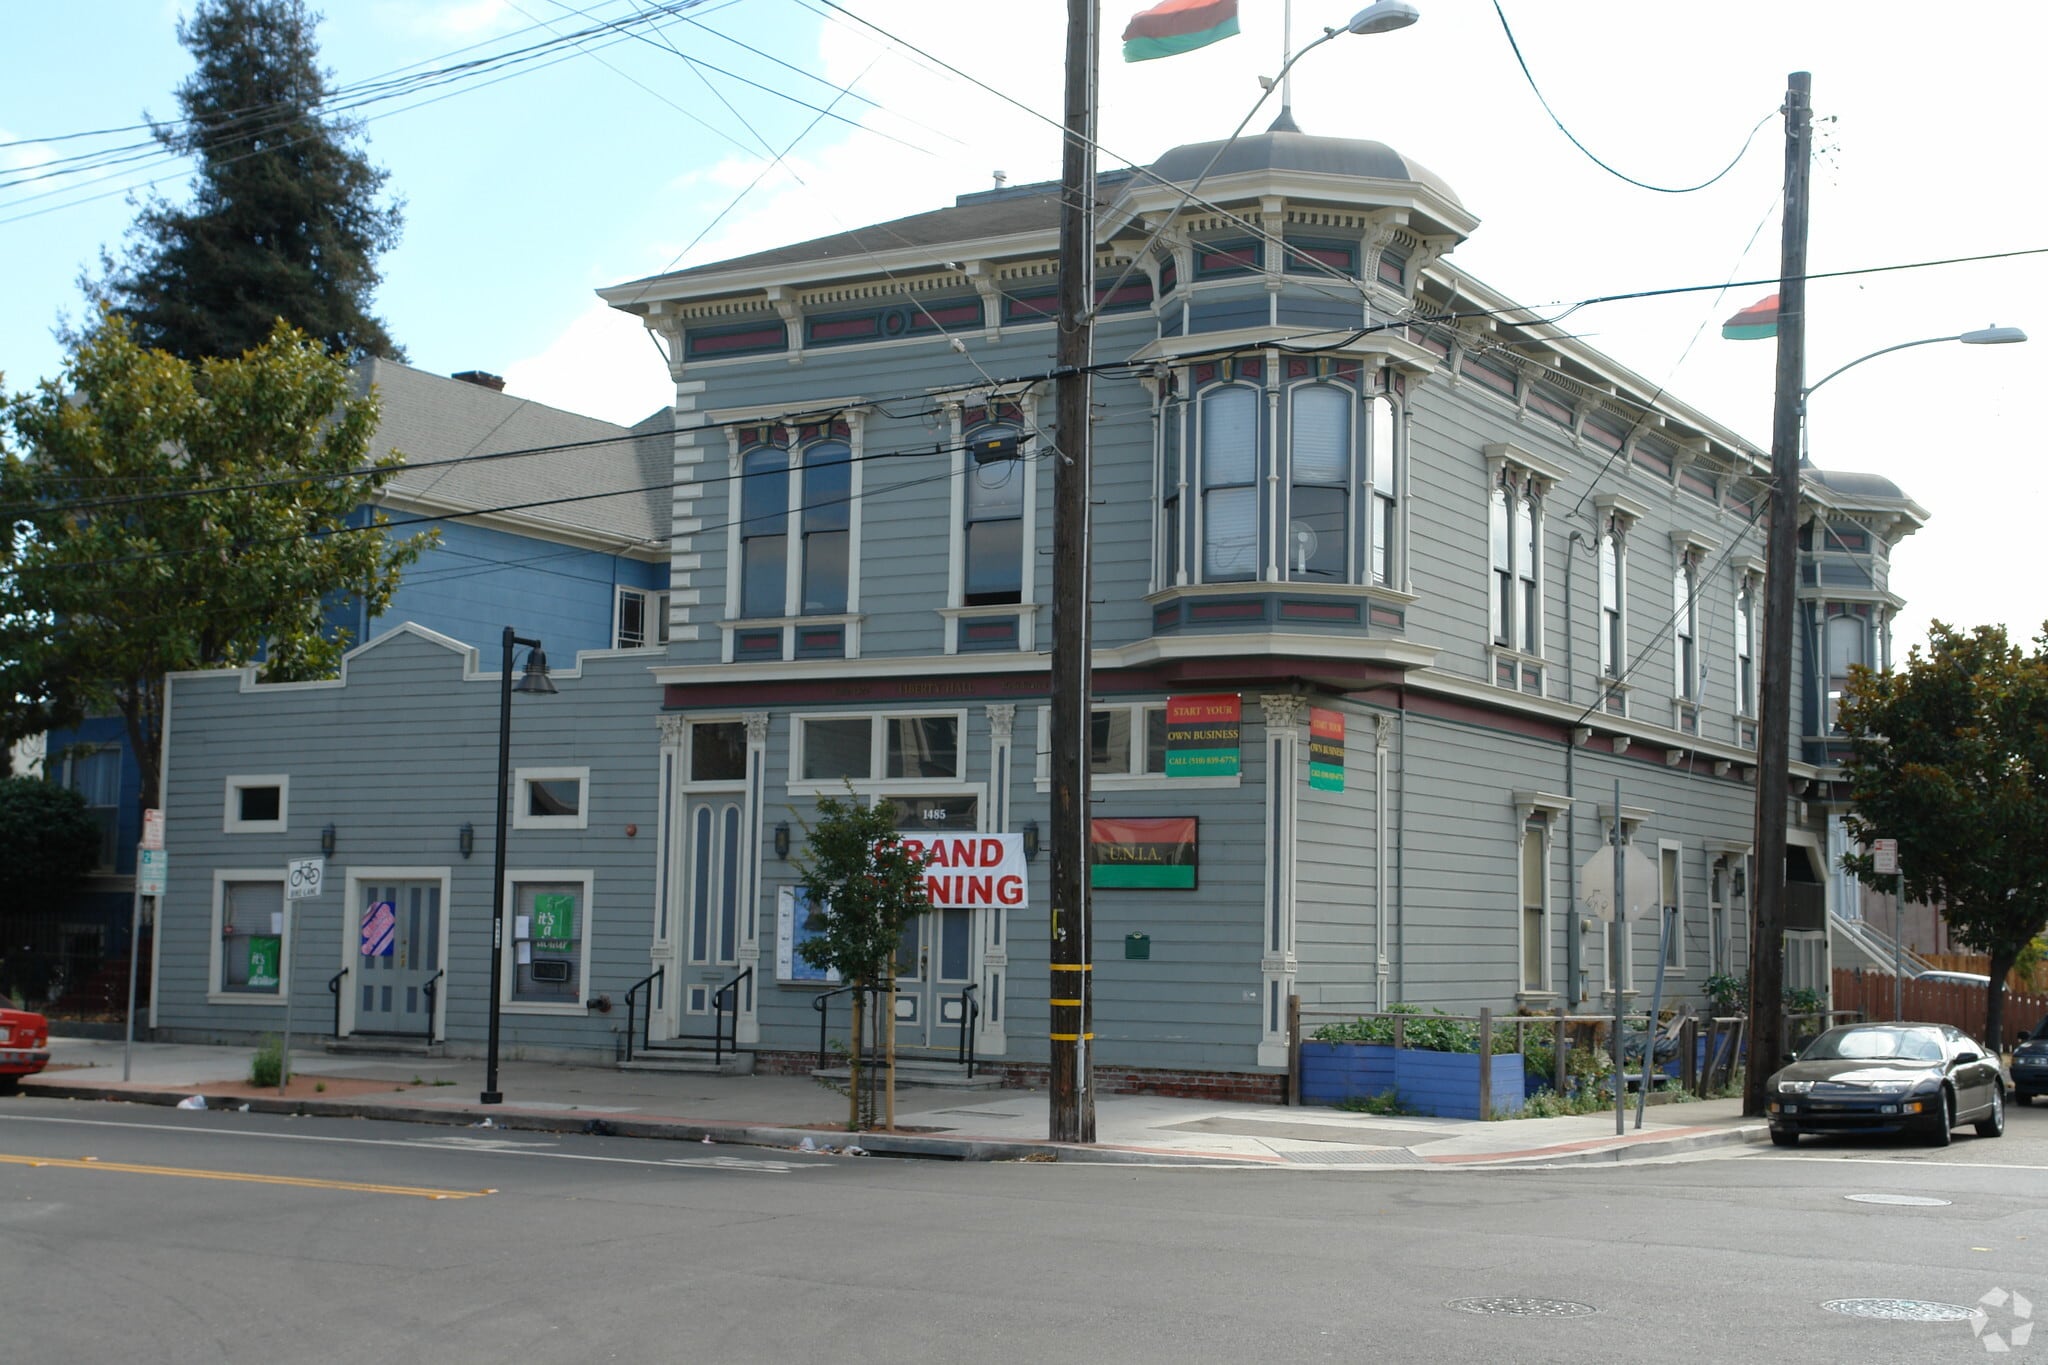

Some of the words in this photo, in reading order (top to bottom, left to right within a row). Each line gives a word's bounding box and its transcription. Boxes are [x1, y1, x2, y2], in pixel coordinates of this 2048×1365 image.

[1174, 707, 1201, 717] START
[1206, 705, 1233, 715] YOUR
[1167, 731, 1192, 741] OWN
[1193, 729, 1239, 740] BUSINESS
[1169, 757, 1188, 765] CALL
[923, 808, 946, 820] 1485
[1109, 847, 1162, 861] U.N.I.A.
[538, 911, 555, 925] it's
